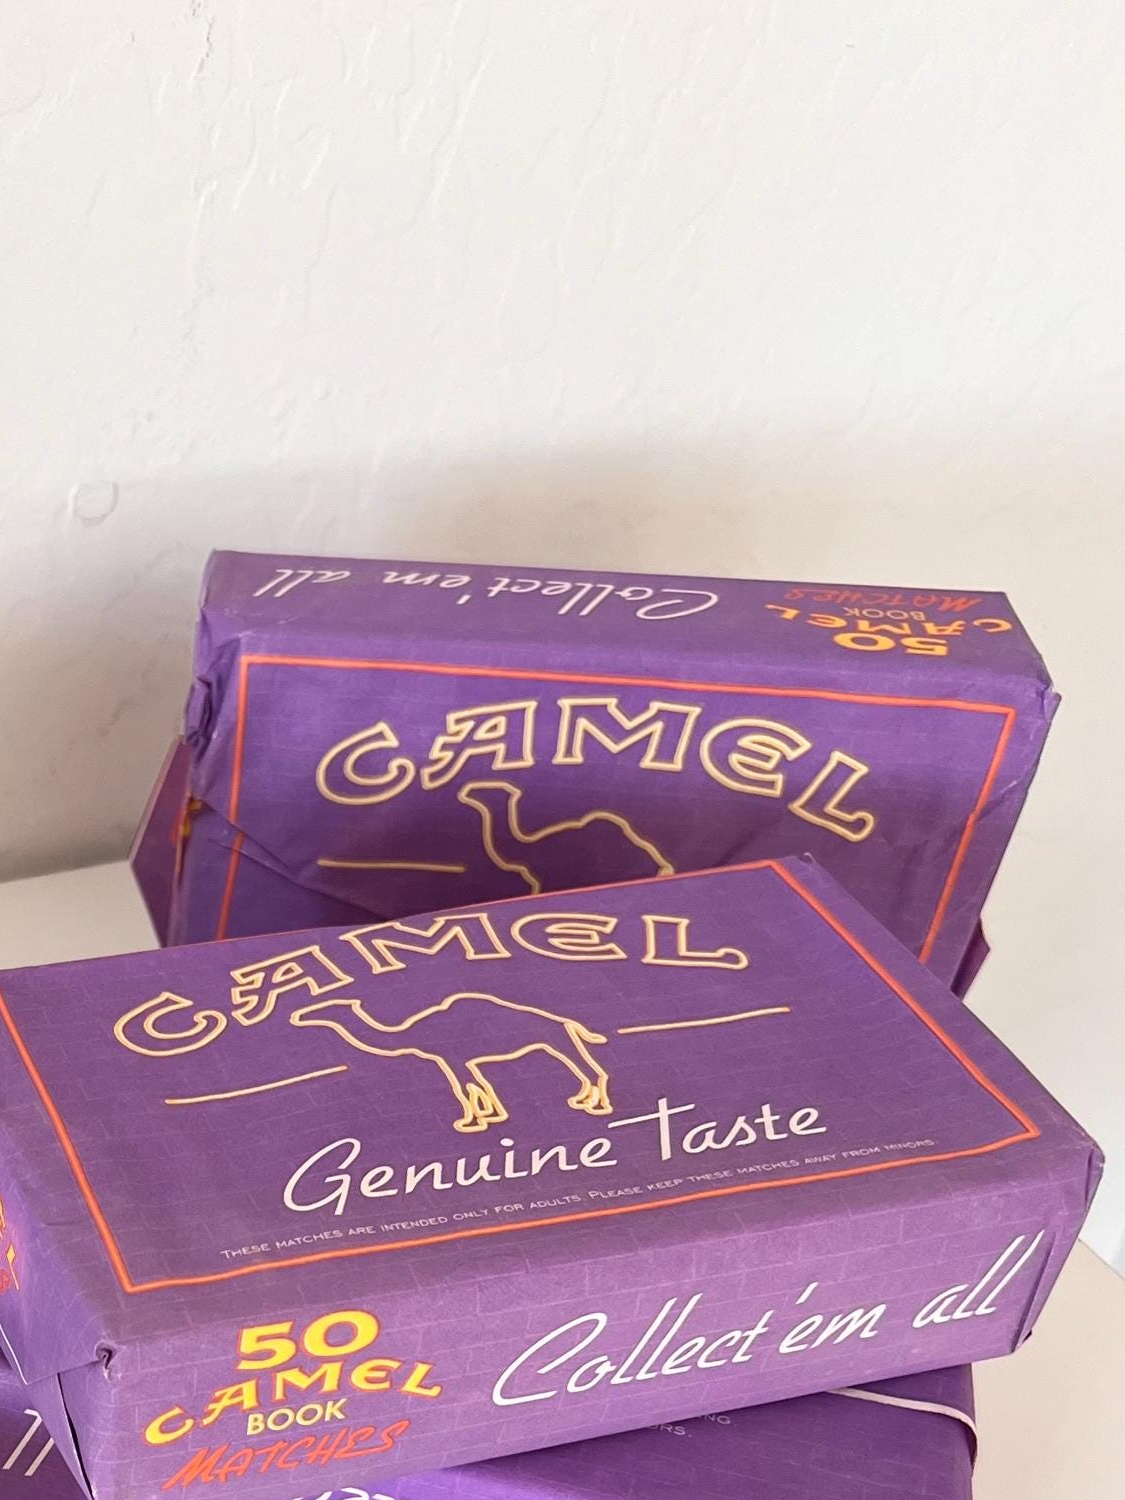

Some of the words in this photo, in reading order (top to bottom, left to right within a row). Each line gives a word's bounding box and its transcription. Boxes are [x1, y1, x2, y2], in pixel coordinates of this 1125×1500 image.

[253, 567, 351, 598] all
[487, 576, 719, 620] Collect
[784, 585, 983, 613] MATCHES
[764, 604, 1014, 636] CAMEL
[833, 632, 948, 656] 50
[843, 607, 925, 621] BOOK
[316, 697, 877, 843] CAMEL
[113, 912, 752, 1058] CAMEL
[282, 1138, 619, 1216] Genuine
[606, 1097, 828, 1162] Taste
[220, 1241, 272, 1260] THESE
[275, 1229, 343, 1250] MATCHES
[348, 1225, 376, 1237] ARE
[380, 1215, 449, 1233] INTENDED
[453, 1208, 490, 1222] ONLY
[495, 1203, 525, 1215] FOR
[588, 1185, 642, 1201] PLEASE
[647, 1177, 684, 1192] KEEP
[687, 1169, 735, 1185] THESE
[737, 1159, 800, 1175] MATCHES
[804, 1153, 837, 1166] AWAY
[841, 1146, 881, 1160] FROM
[236, 1309, 380, 1370] 50
[492, 1292, 774, 1406] Collect
[911, 1229, 1045, 1328] all
[144, 1358, 443, 1445] CAMEL
[246, 1398, 348, 1436] BOOK
[161, 1418, 412, 1490] MATCHES
